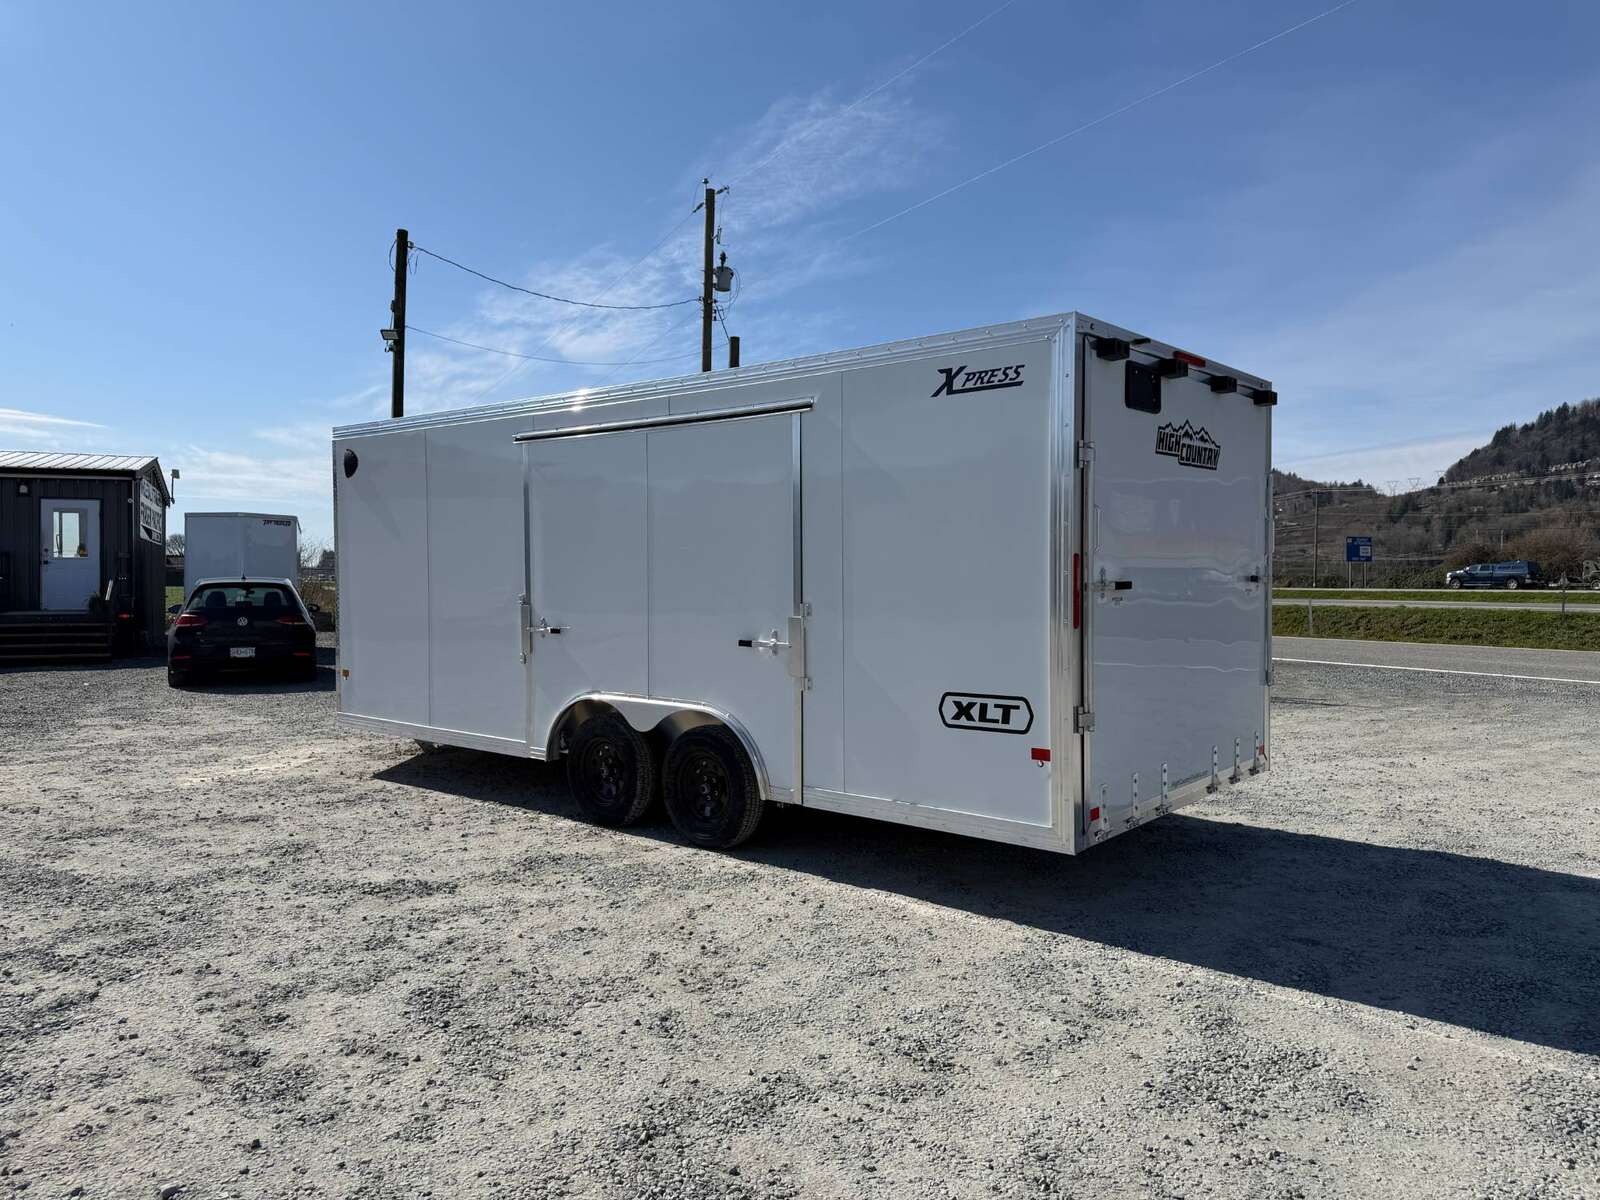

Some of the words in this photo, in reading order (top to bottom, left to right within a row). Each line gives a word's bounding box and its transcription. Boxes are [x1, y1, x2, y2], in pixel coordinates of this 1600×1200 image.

[930, 364, 1025, 397] XPRESS
[1157, 430, 1182, 453] HIGH
[1179, 443, 1219, 467] COUNTRY
[951, 700, 1020, 724] XLT
